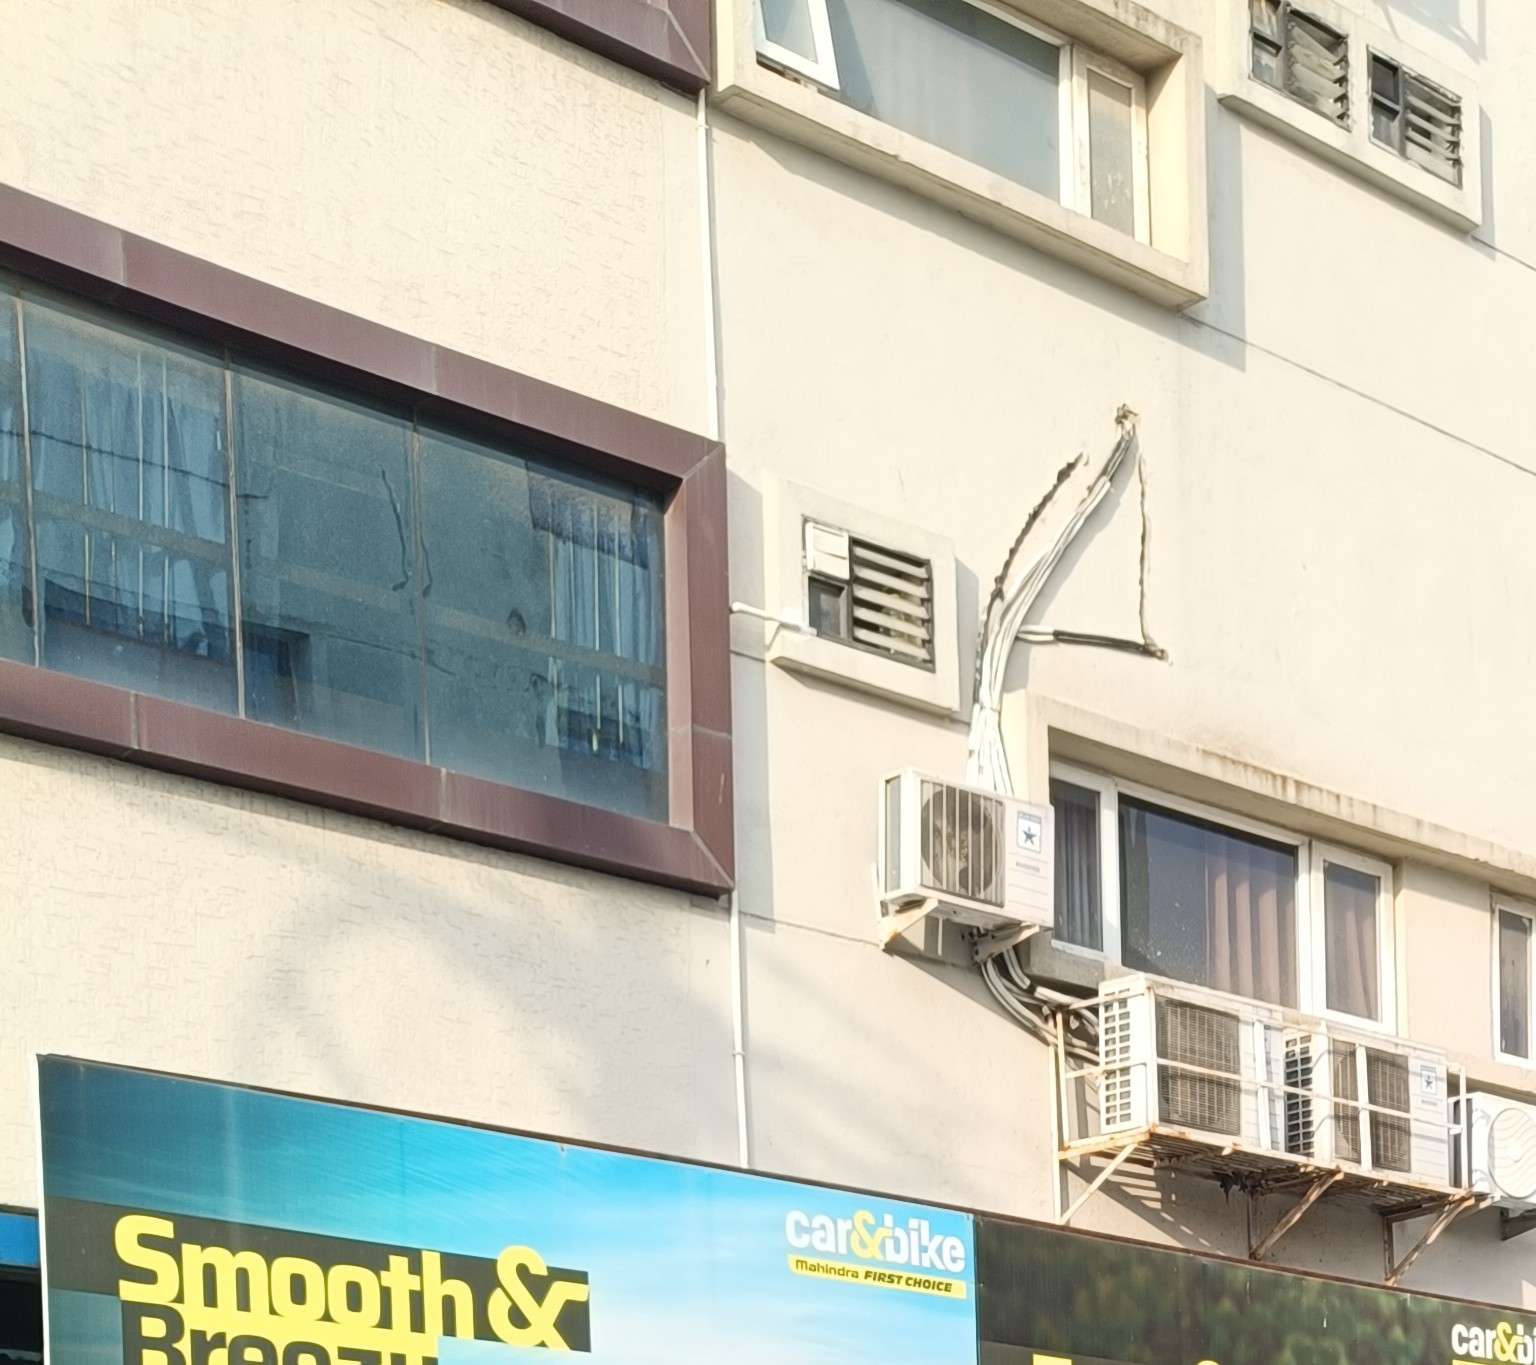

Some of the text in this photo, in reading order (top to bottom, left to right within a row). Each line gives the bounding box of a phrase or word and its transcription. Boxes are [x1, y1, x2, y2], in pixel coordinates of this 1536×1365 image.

[785, 1209, 966, 1273] car&bike
[114, 1214, 589, 1351] Smooth &
[795, 1259, 953, 1293] Mahindra FIRST CHOICE
